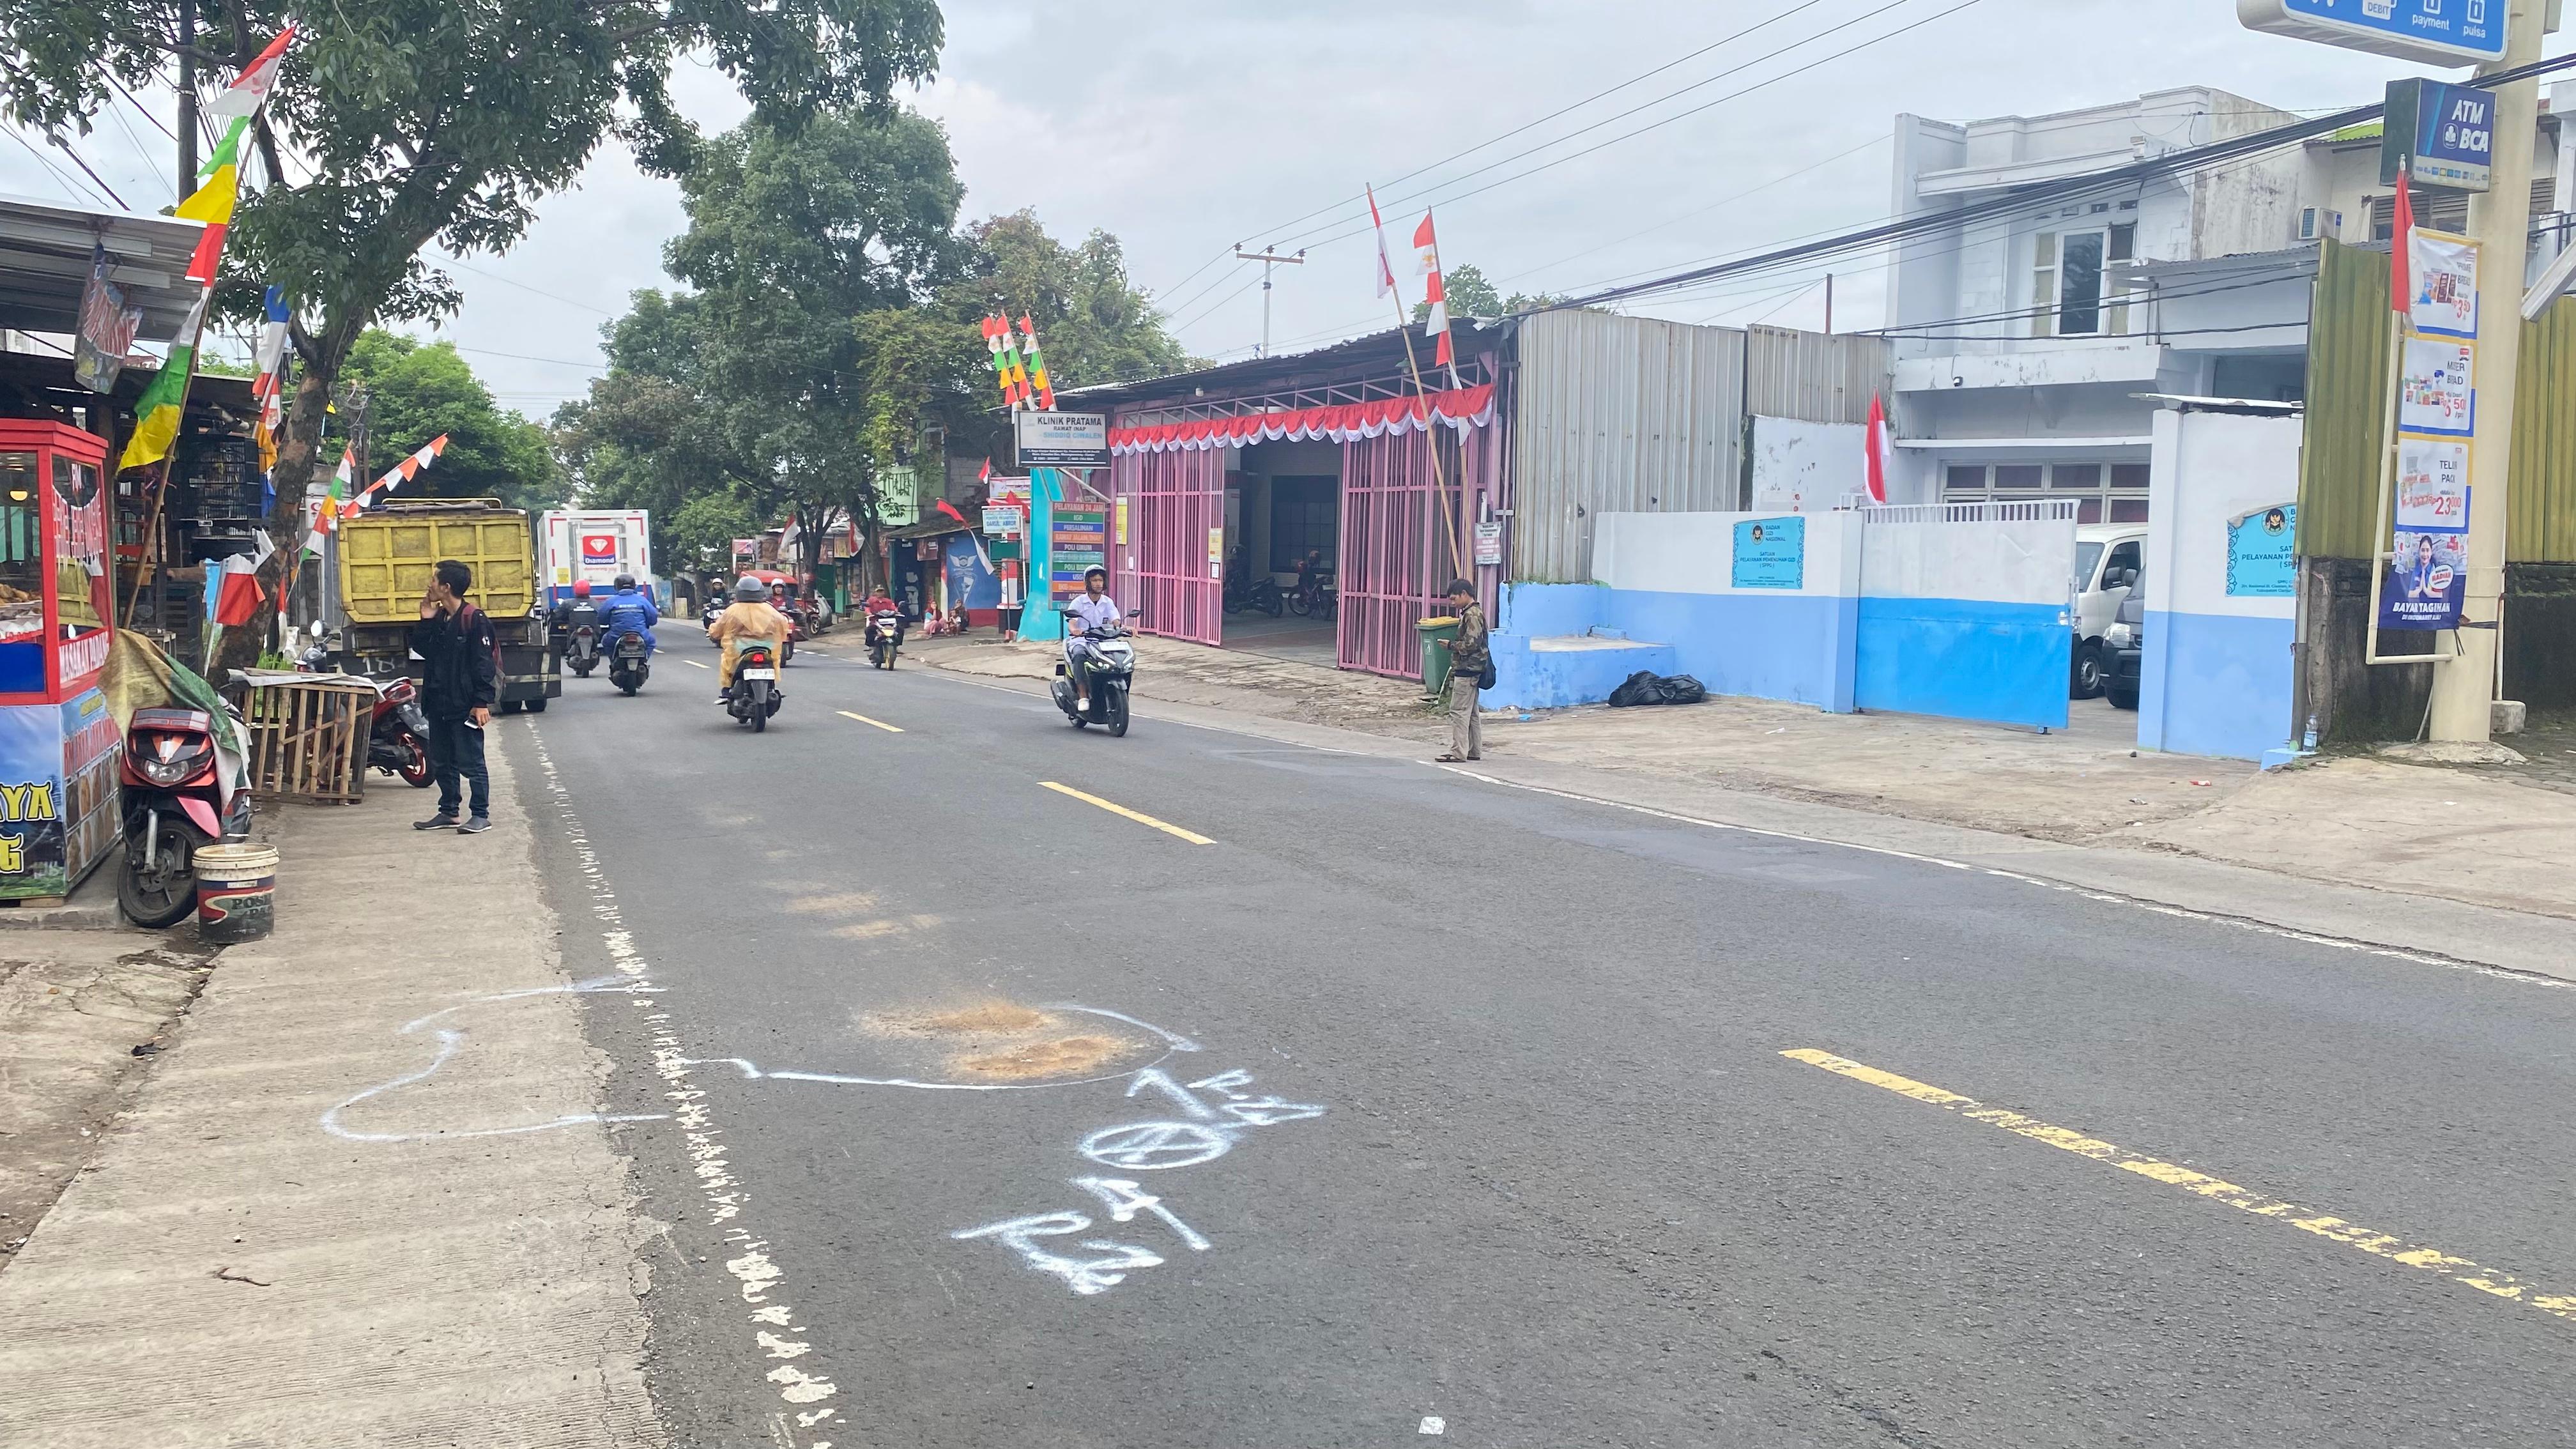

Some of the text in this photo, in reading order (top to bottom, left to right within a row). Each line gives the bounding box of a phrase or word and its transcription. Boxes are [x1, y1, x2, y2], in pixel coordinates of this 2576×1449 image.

[2368, 3, 2389, 15] DEBIT
[2412, 14, 2450, 31] payment
[2463, 25, 2486, 38] pulsa
[2451, 99, 2485, 125] ATM
[2459, 128, 2489, 152] BCA
[1038, 417, 1101, 425] KLINIK PRATAMA
[1054, 503, 1084, 511] PELAYANAN
[2393, 602, 2450, 613] BAYAR TAGIHAN
[0, 781, 56, 822] YA
